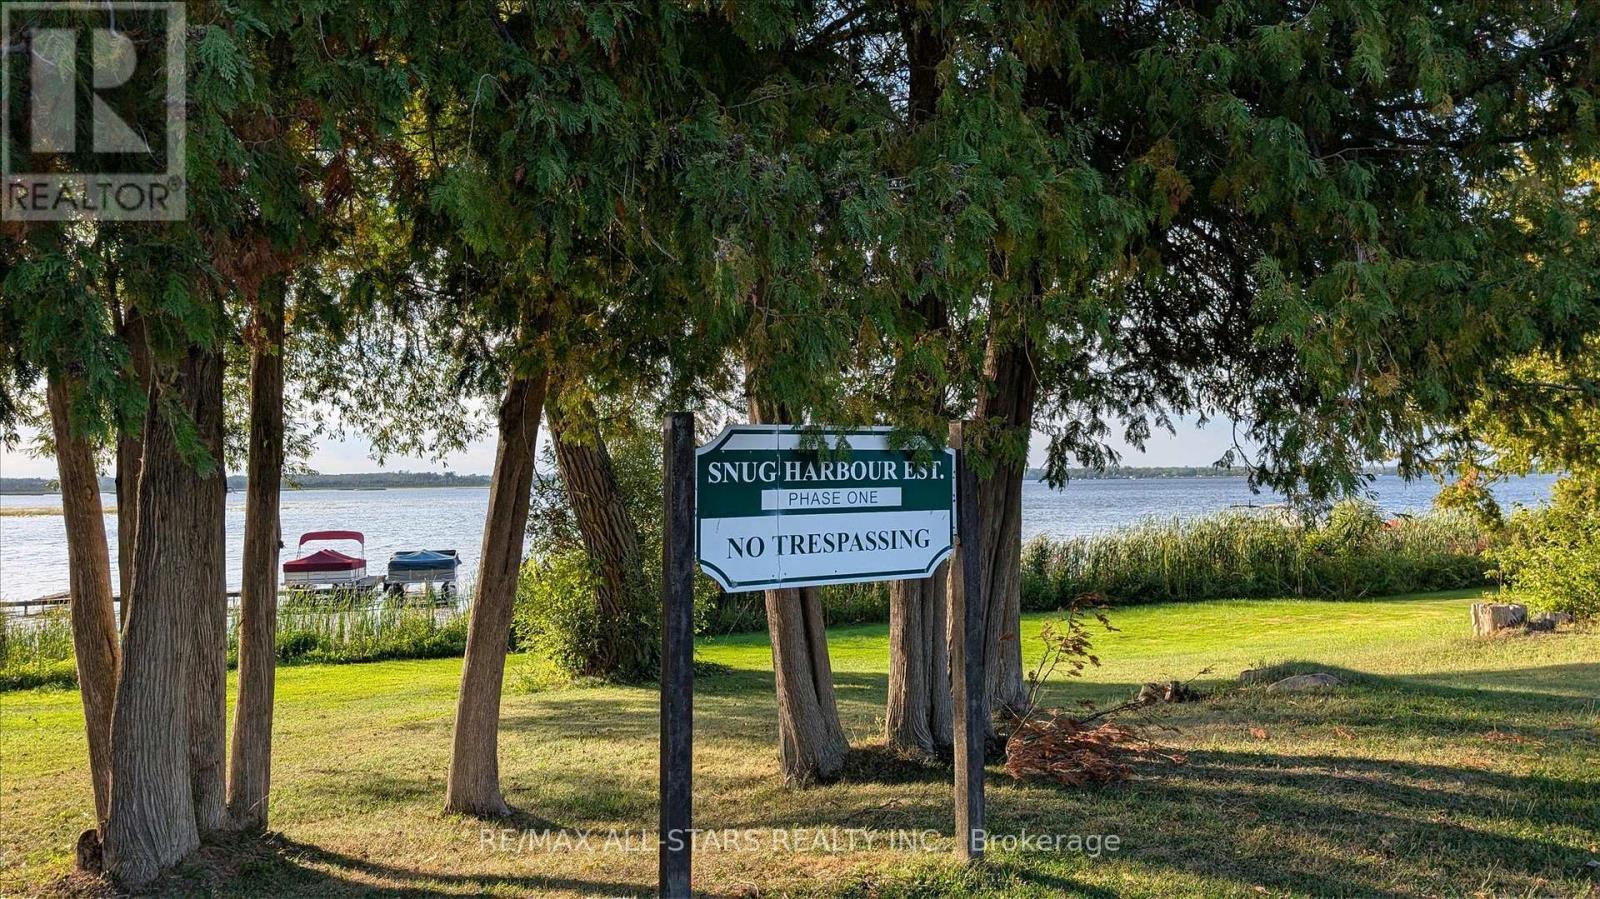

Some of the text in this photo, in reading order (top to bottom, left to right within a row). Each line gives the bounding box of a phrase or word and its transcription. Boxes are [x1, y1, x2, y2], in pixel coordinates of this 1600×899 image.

[707, 460, 945, 484] SNUG HARBOUR EST.
[788, 490, 879, 506] PHASE ONE
[727, 528, 931, 559] NO TRESPASSING
